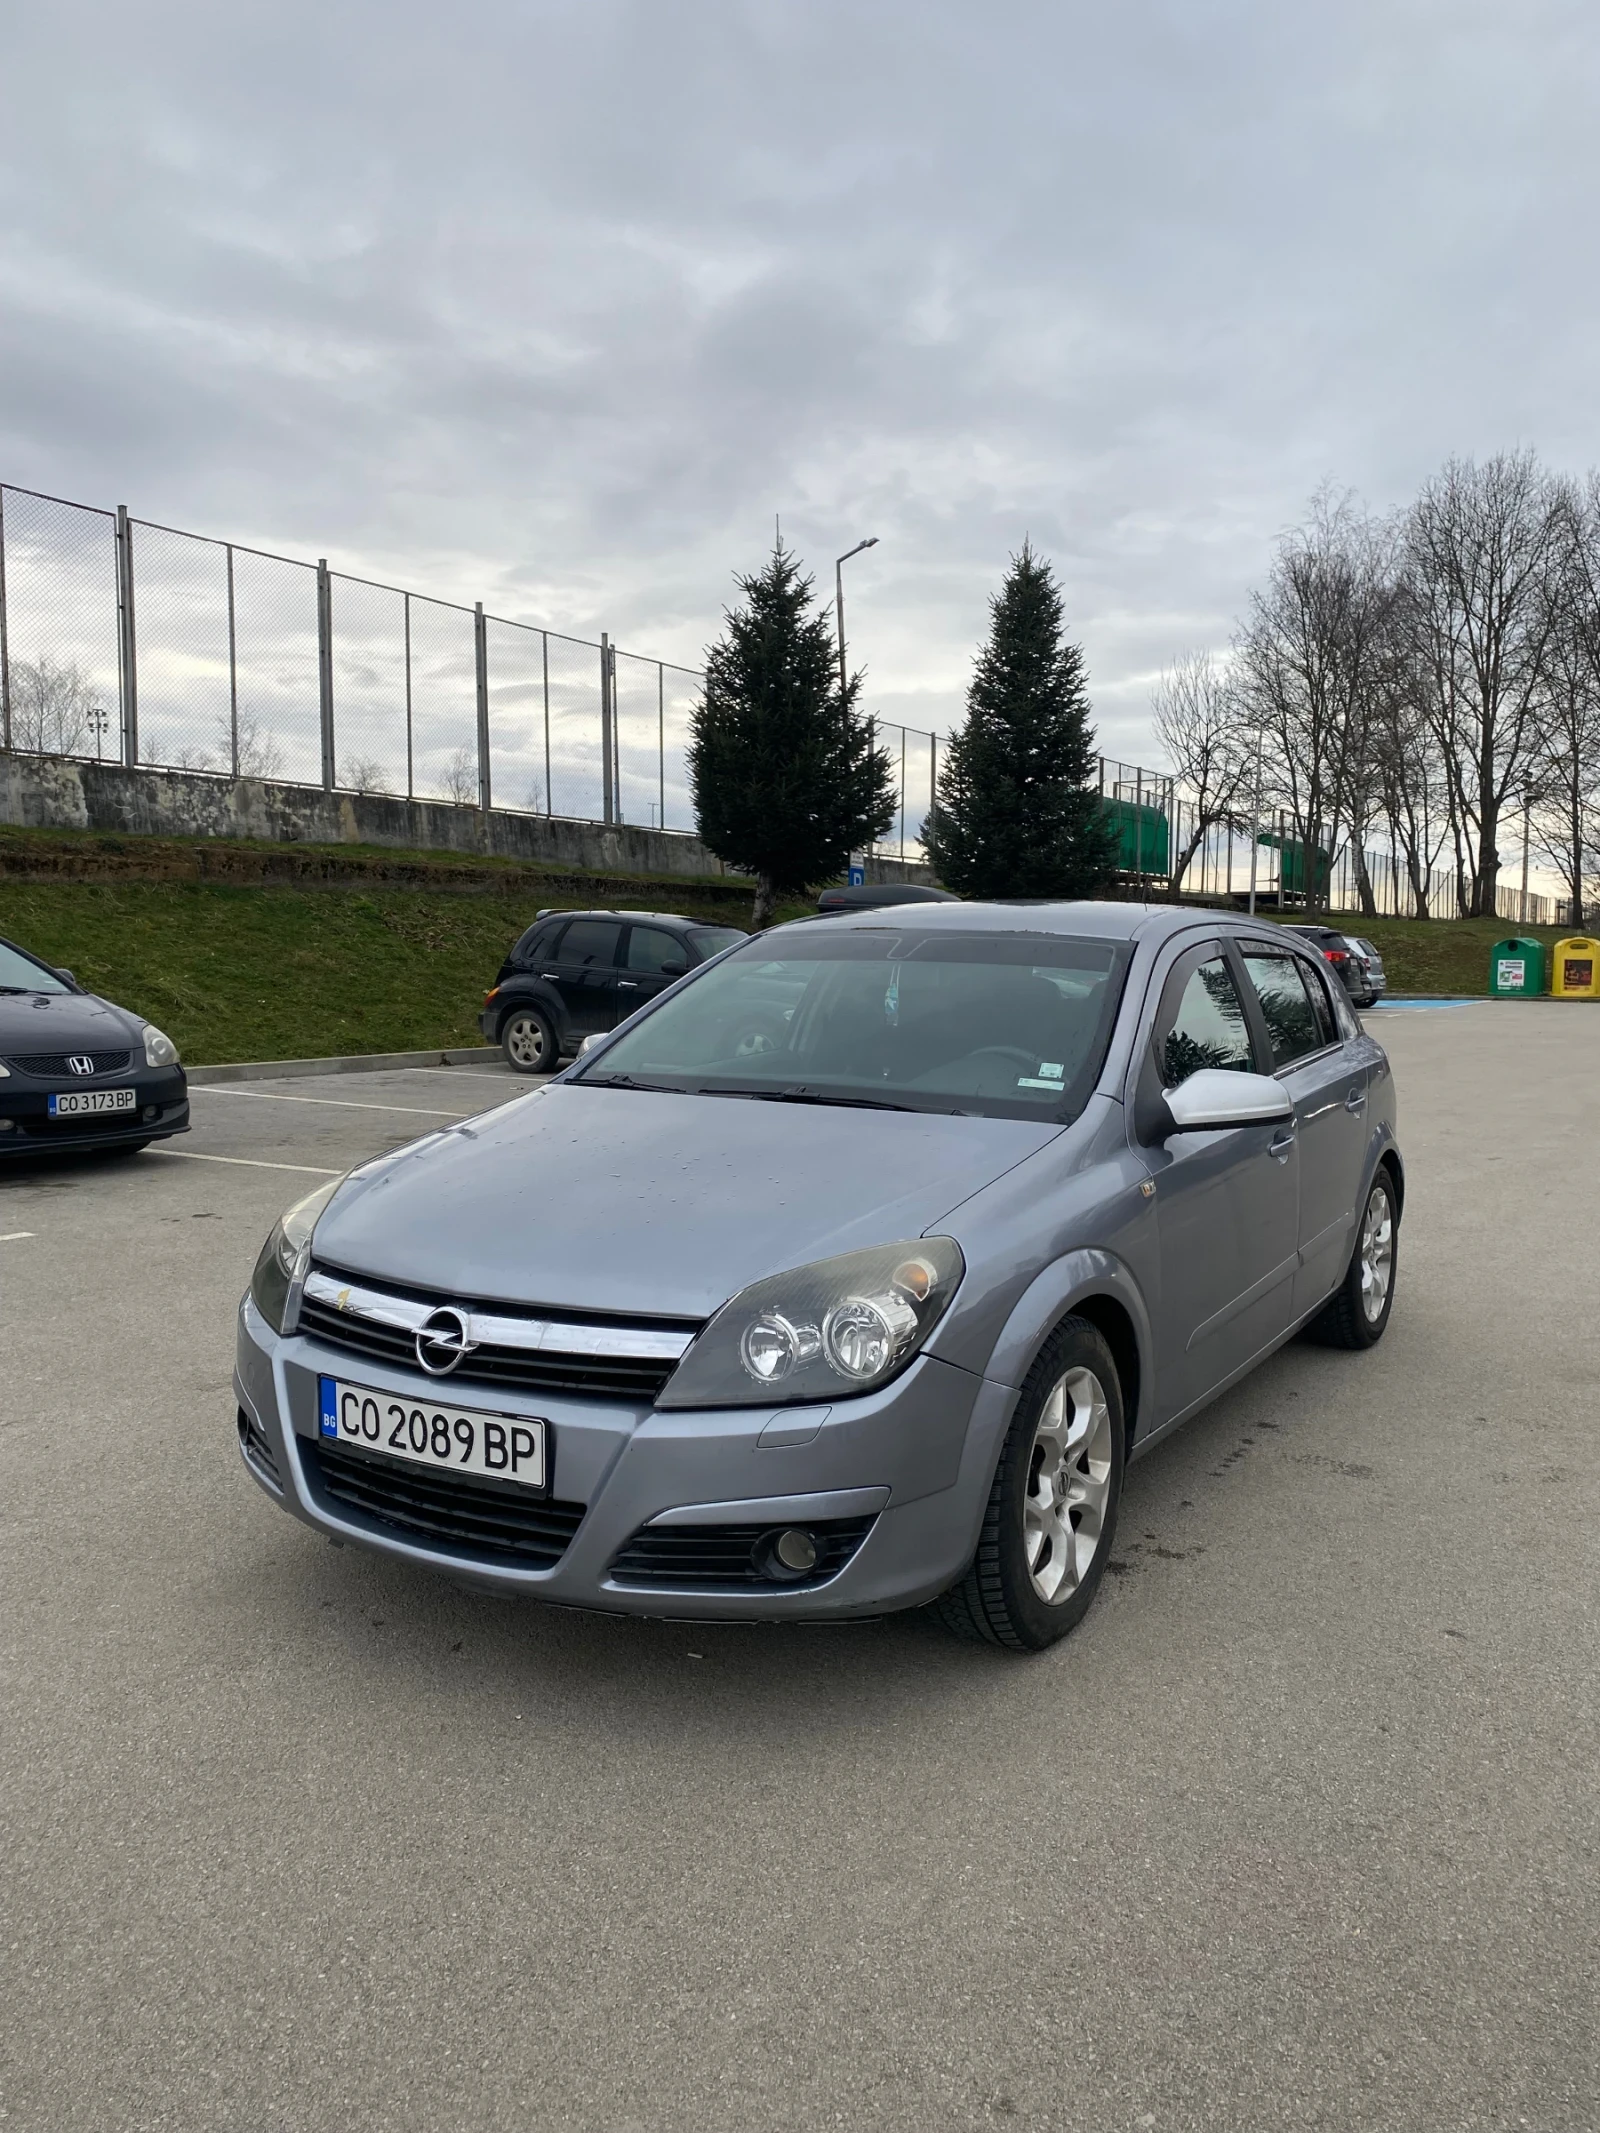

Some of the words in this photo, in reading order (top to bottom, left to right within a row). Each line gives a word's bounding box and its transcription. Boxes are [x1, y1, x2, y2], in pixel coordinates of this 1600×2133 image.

[81, 1093, 114, 1110] 3173
[323, 1413, 336, 1428] BG
[387, 1404, 474, 1463] 2089
[484, 1422, 535, 1472] BP
